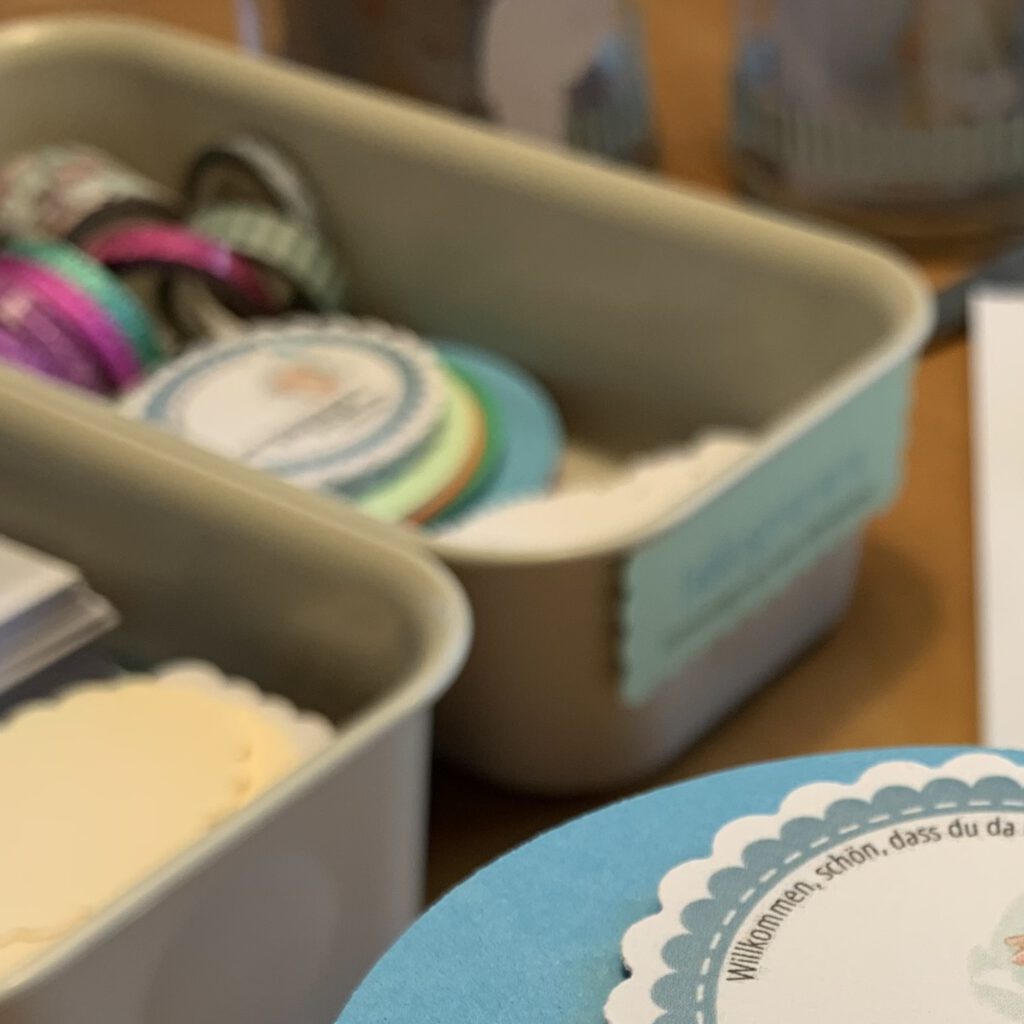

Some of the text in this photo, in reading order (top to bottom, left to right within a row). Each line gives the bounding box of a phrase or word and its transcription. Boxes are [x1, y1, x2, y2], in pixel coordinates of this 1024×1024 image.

[726, 880, 825, 981] Willkommen,
[815, 842, 889, 882] schön,
[889, 825, 942, 850] dass
[948, 819, 978, 838] du
[986, 818, 1015, 837] da
